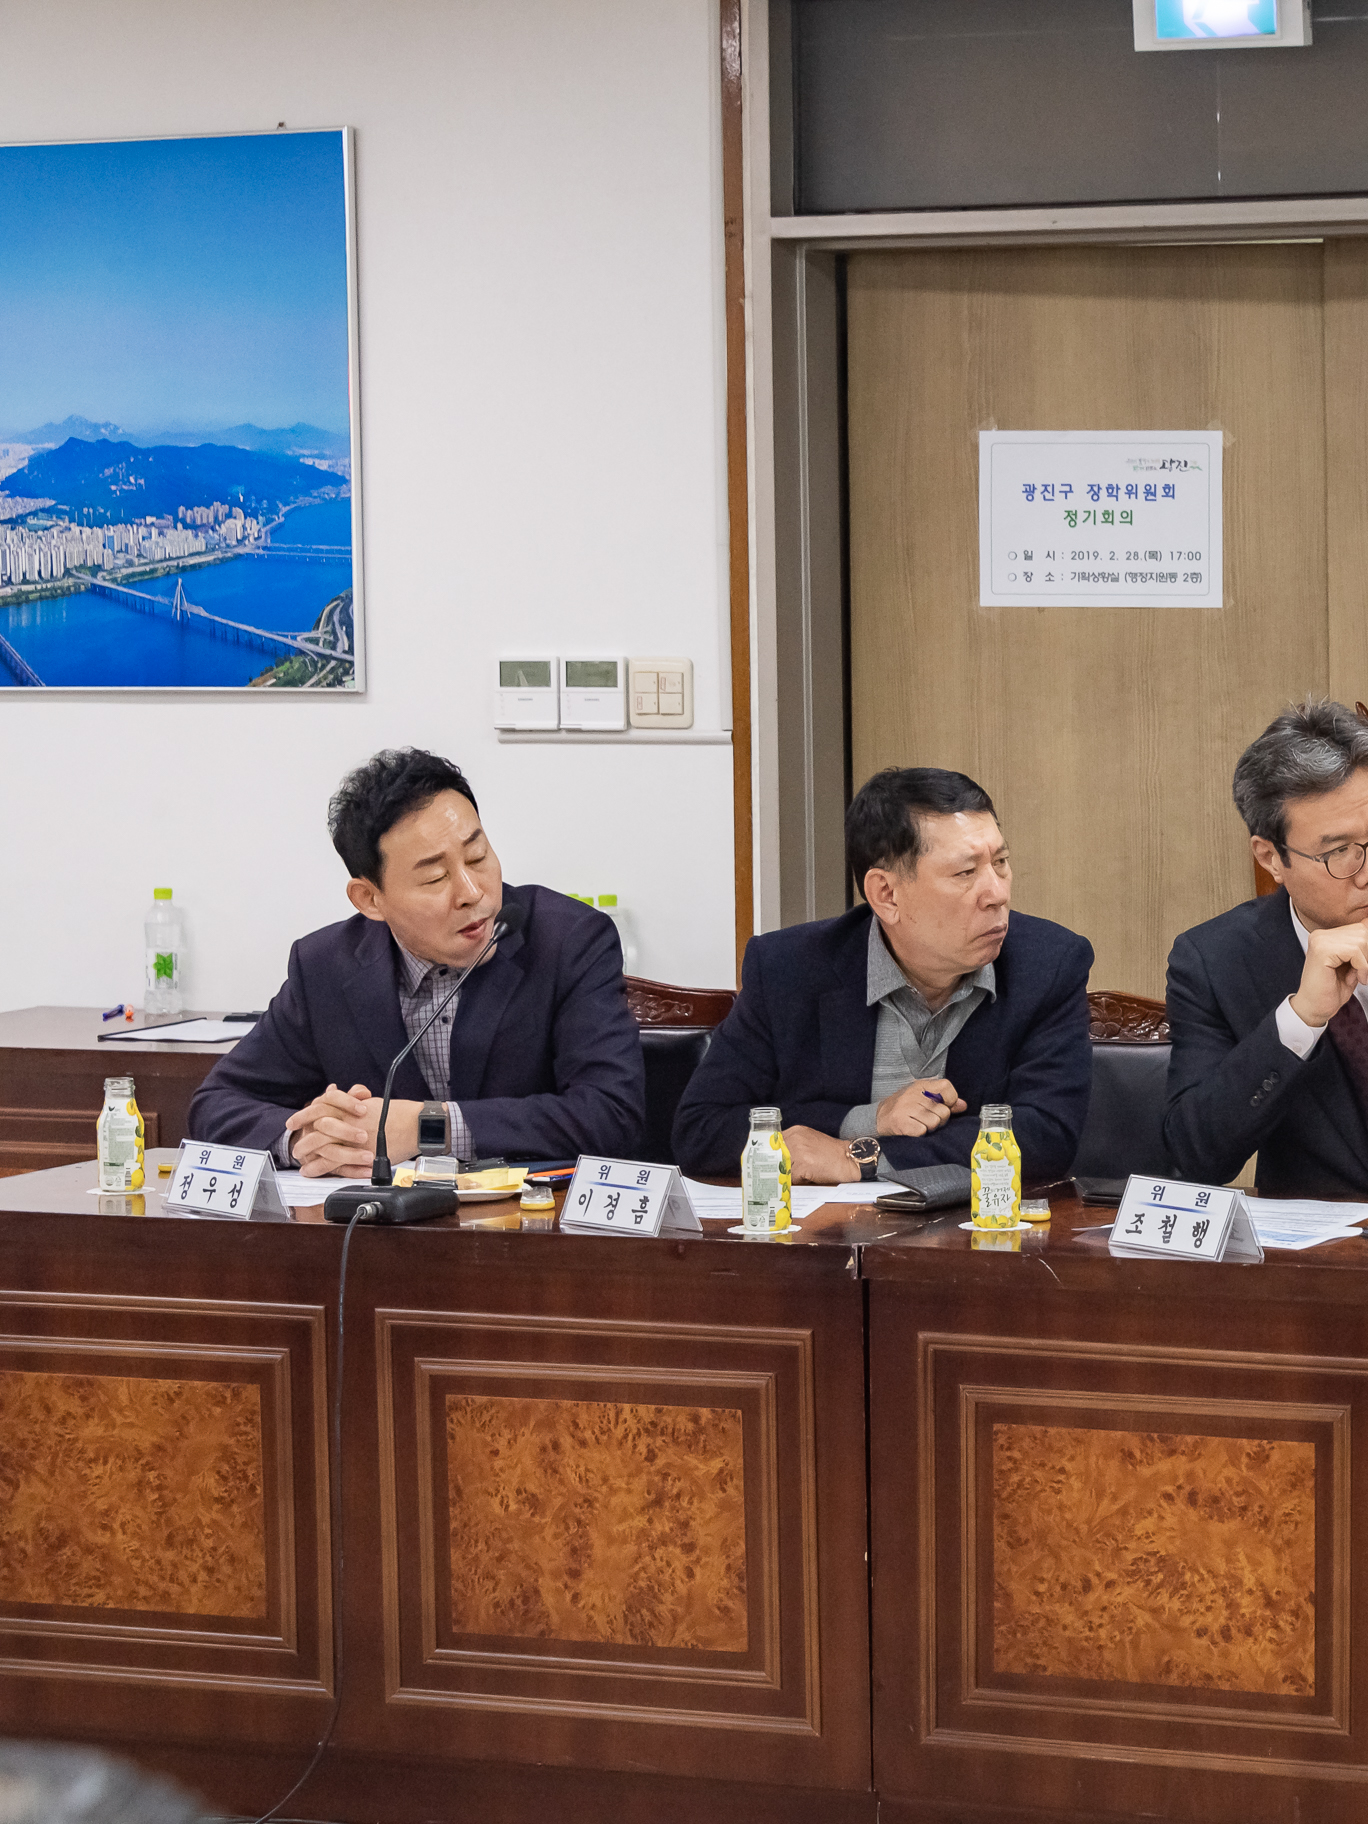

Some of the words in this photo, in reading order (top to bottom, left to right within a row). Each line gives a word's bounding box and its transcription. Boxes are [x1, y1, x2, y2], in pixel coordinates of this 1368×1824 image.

[1022, 483, 1074, 502] 광진구
[1086, 483, 1175, 502] 장학위원회
[1064, 510, 1133, 528] 정기회의
[1071, 551, 1102, 561] 2019.
[1170, 551, 1202, 561] 17:00
[180, 1173, 243, 1208] 정우성
[1125, 1213, 1210, 1248] 조철행
